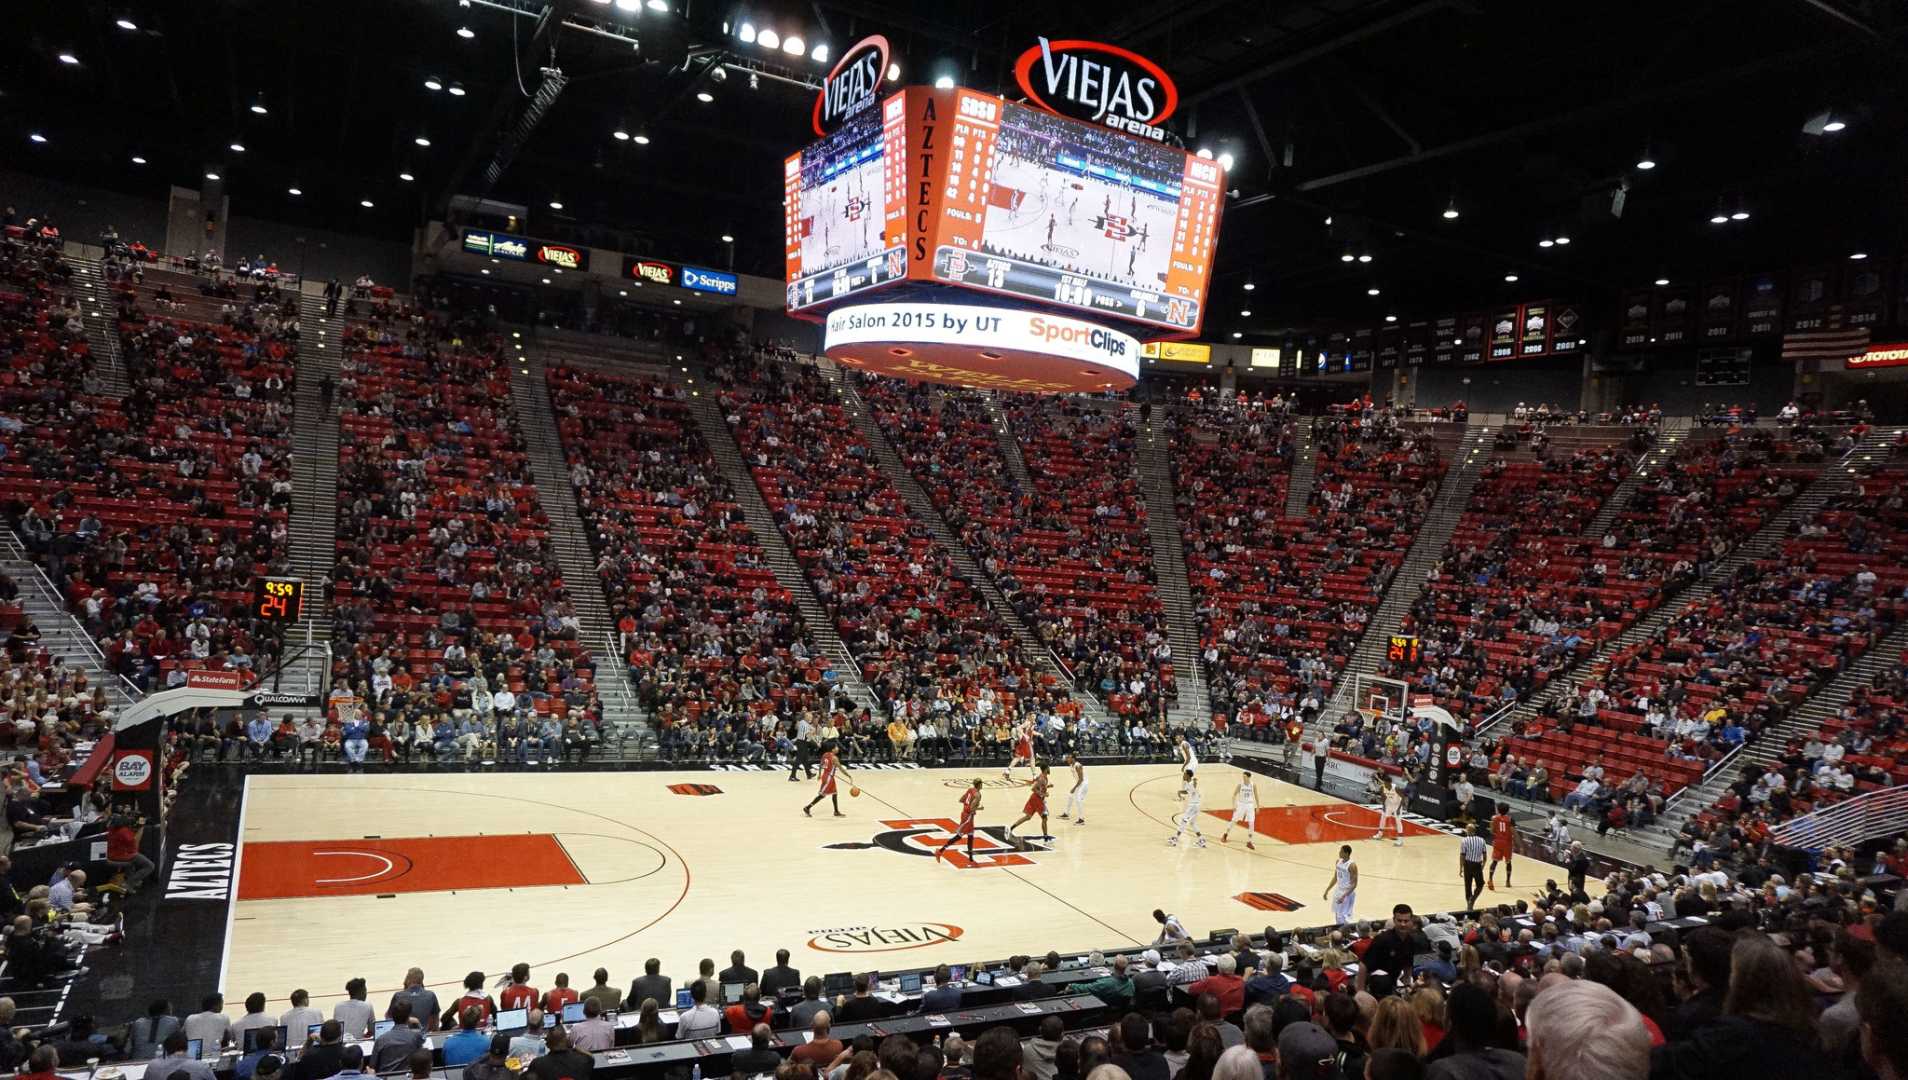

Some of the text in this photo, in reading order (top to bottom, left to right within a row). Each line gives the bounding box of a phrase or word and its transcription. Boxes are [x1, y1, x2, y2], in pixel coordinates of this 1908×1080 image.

[823, 51, 877, 121] VIEJAS
[1038, 35, 1155, 121] VIEJAS
[844, 92, 875, 120] arena
[960, 96, 997, 122] SDSU
[1105, 113, 1164, 141] arena
[915, 96, 936, 262] AZTECS
[543, 245, 576, 264] VIEJAS
[637, 262, 668, 279] VIEJAS
[699, 274, 737, 293] Scripps
[849, 312, 886, 331] Salon
[892, 312, 936, 330] 2015
[943, 312, 969, 335] by
[976, 315, 1002, 335] UT
[265, 581, 293, 597] 9:59
[261, 595, 287, 617] 24
[1390, 646, 1404, 660] 24
[254, 694, 307, 706] QUALCOMM
[119, 761, 147, 771] BAY
[1499, 821, 1506, 833] 11
[164, 842, 235, 900] AZTECS
[825, 925, 960, 949] VIEJAS
